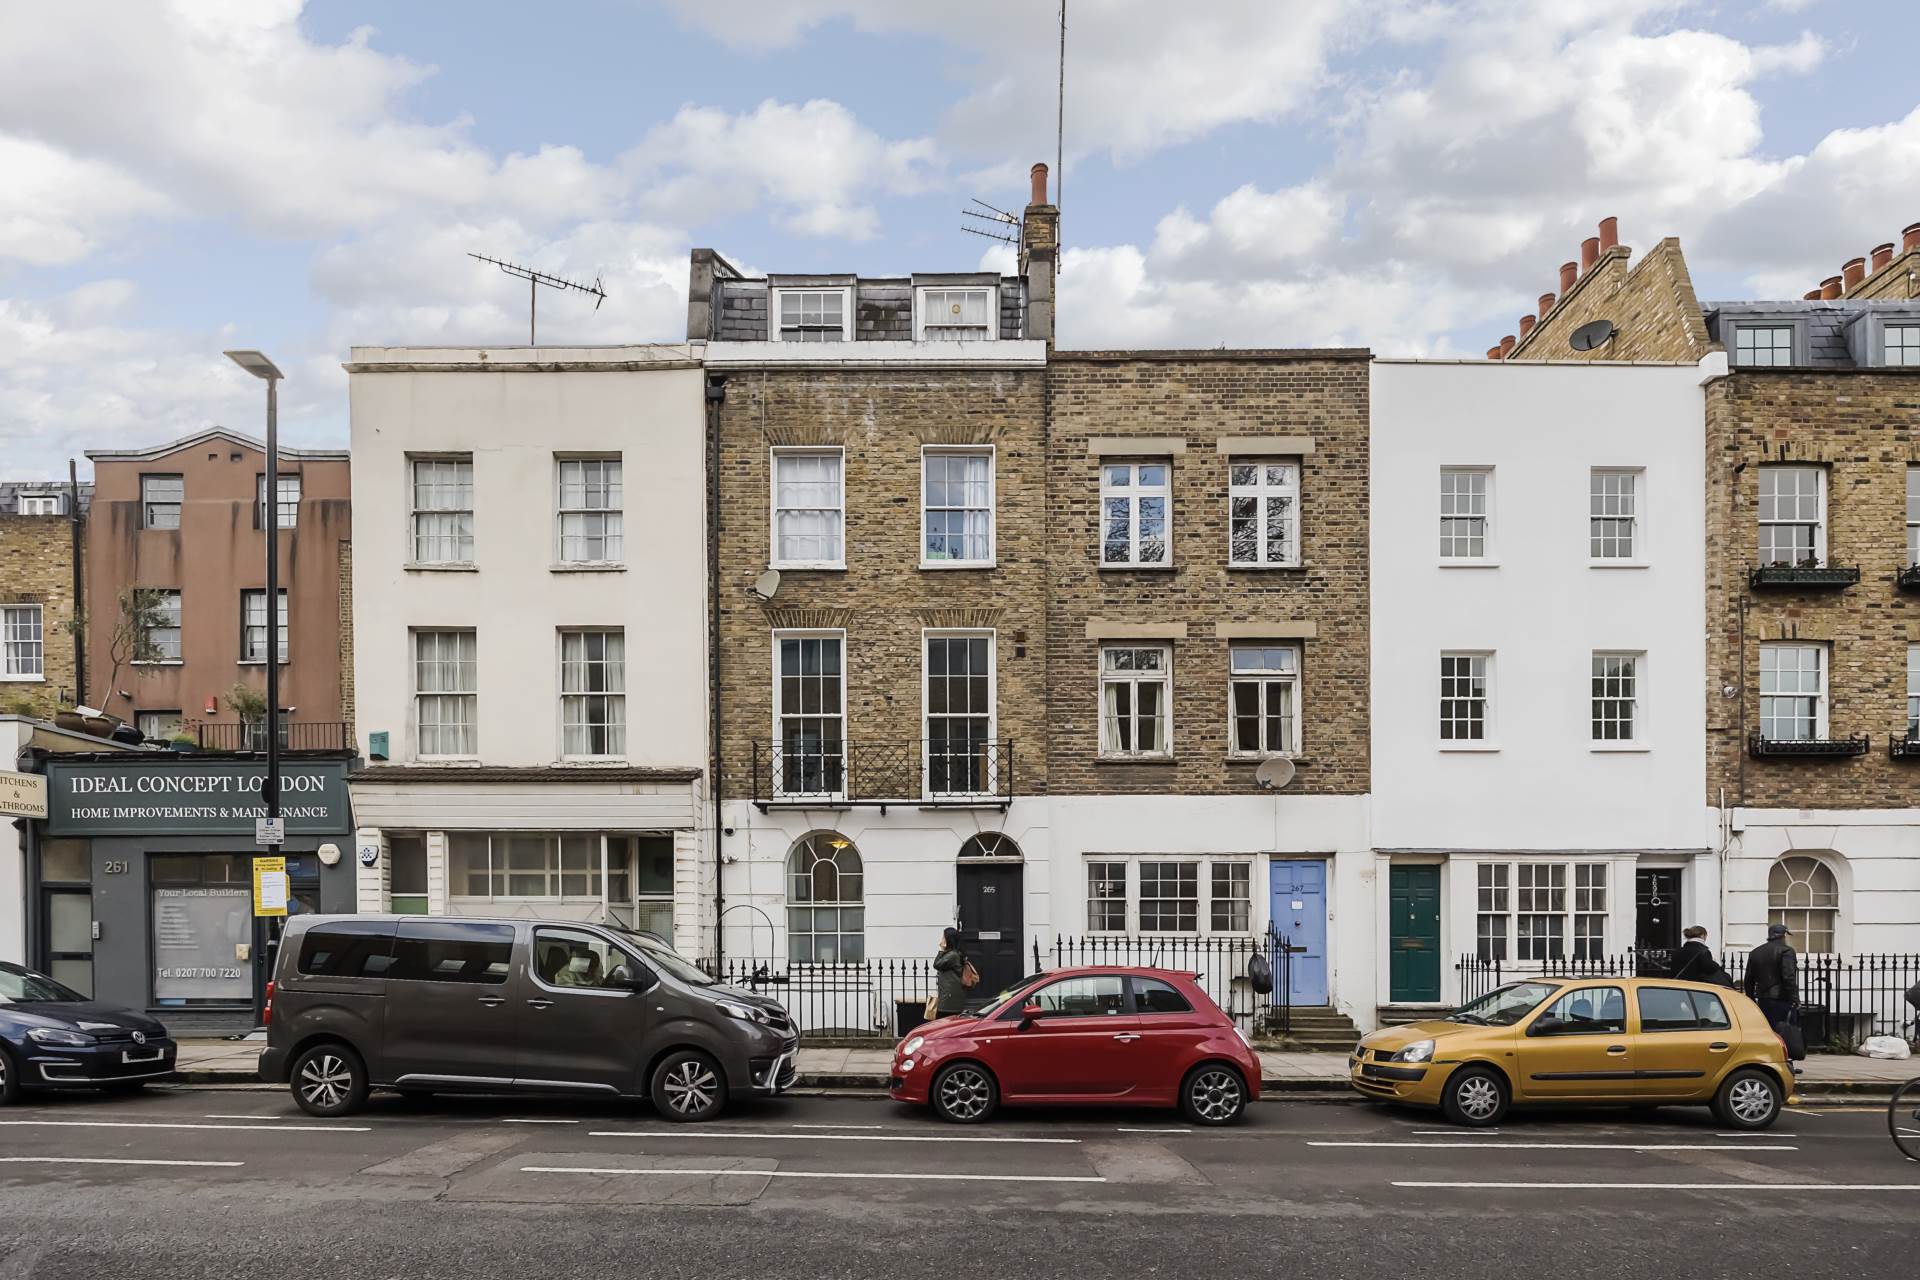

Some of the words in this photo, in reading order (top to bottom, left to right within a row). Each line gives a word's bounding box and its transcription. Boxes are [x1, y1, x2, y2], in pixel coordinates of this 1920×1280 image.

[71, 776, 133, 793] IDEAL
[137, 776, 232, 793] CONCEPT
[237, 776, 326, 792] LODON
[13, 790, 20, 799] &
[0, 801, 45, 813] THROOMS
[71, 807, 111, 819] HOME
[113, 806, 217, 818] IMPROVEMENTS
[219, 806, 229, 818] &
[232, 806, 328, 818] MAINENANCE
[104, 860, 128, 873] 261
[158, 888, 180, 897] Your
[182, 888, 207, 897] Local
[209, 888, 249, 897] Builders
[1291, 884, 1304, 893] 267
[175, 967, 197, 978] 0207
[200, 967, 216, 978] 700
[219, 967, 241, 978] 7220
